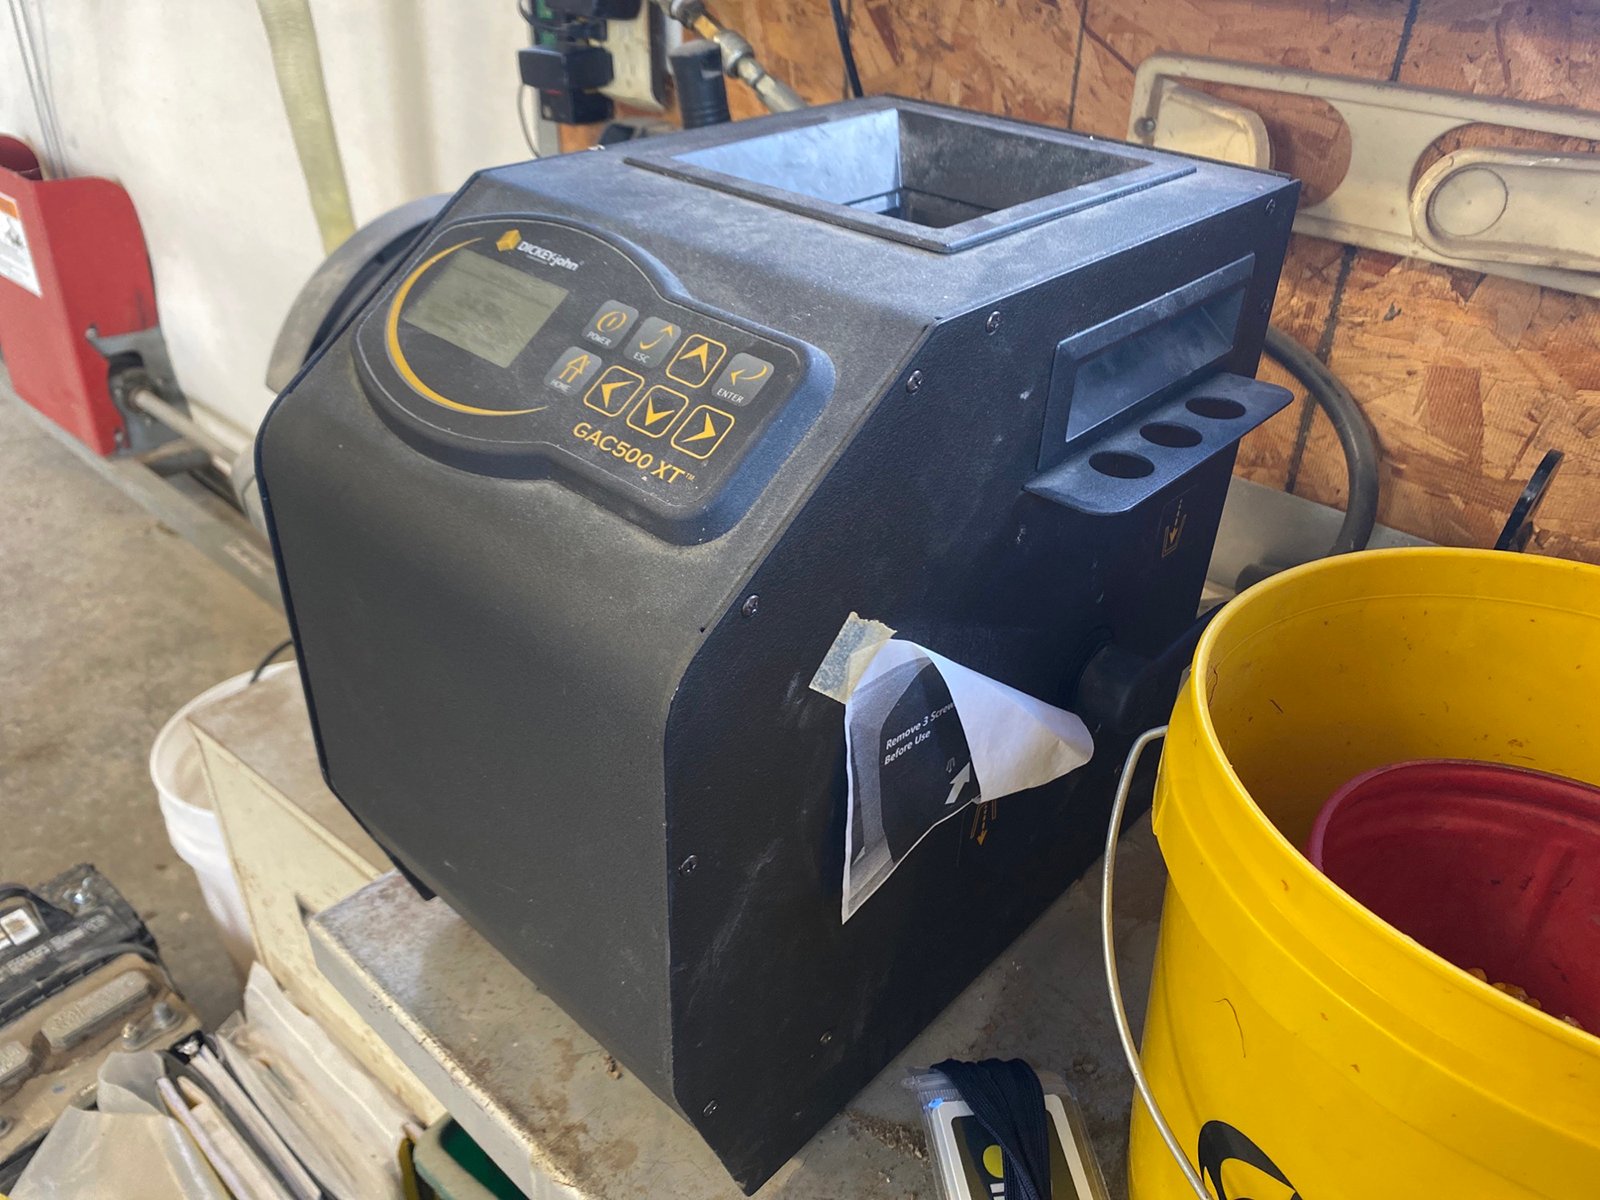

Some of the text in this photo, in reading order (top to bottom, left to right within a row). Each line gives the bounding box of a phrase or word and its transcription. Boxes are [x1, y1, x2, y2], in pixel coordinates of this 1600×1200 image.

[517, 241, 579, 271] DICKEY-john
[586, 330, 612, 346] POWER
[633, 351, 650, 364] ESC
[716, 387, 745, 403] ENTER
[572, 421, 654, 469] GAC500
[884, 730, 931, 765] Before Use
[886, 722, 921, 750] Remove
[922, 715, 929, 727] 3
